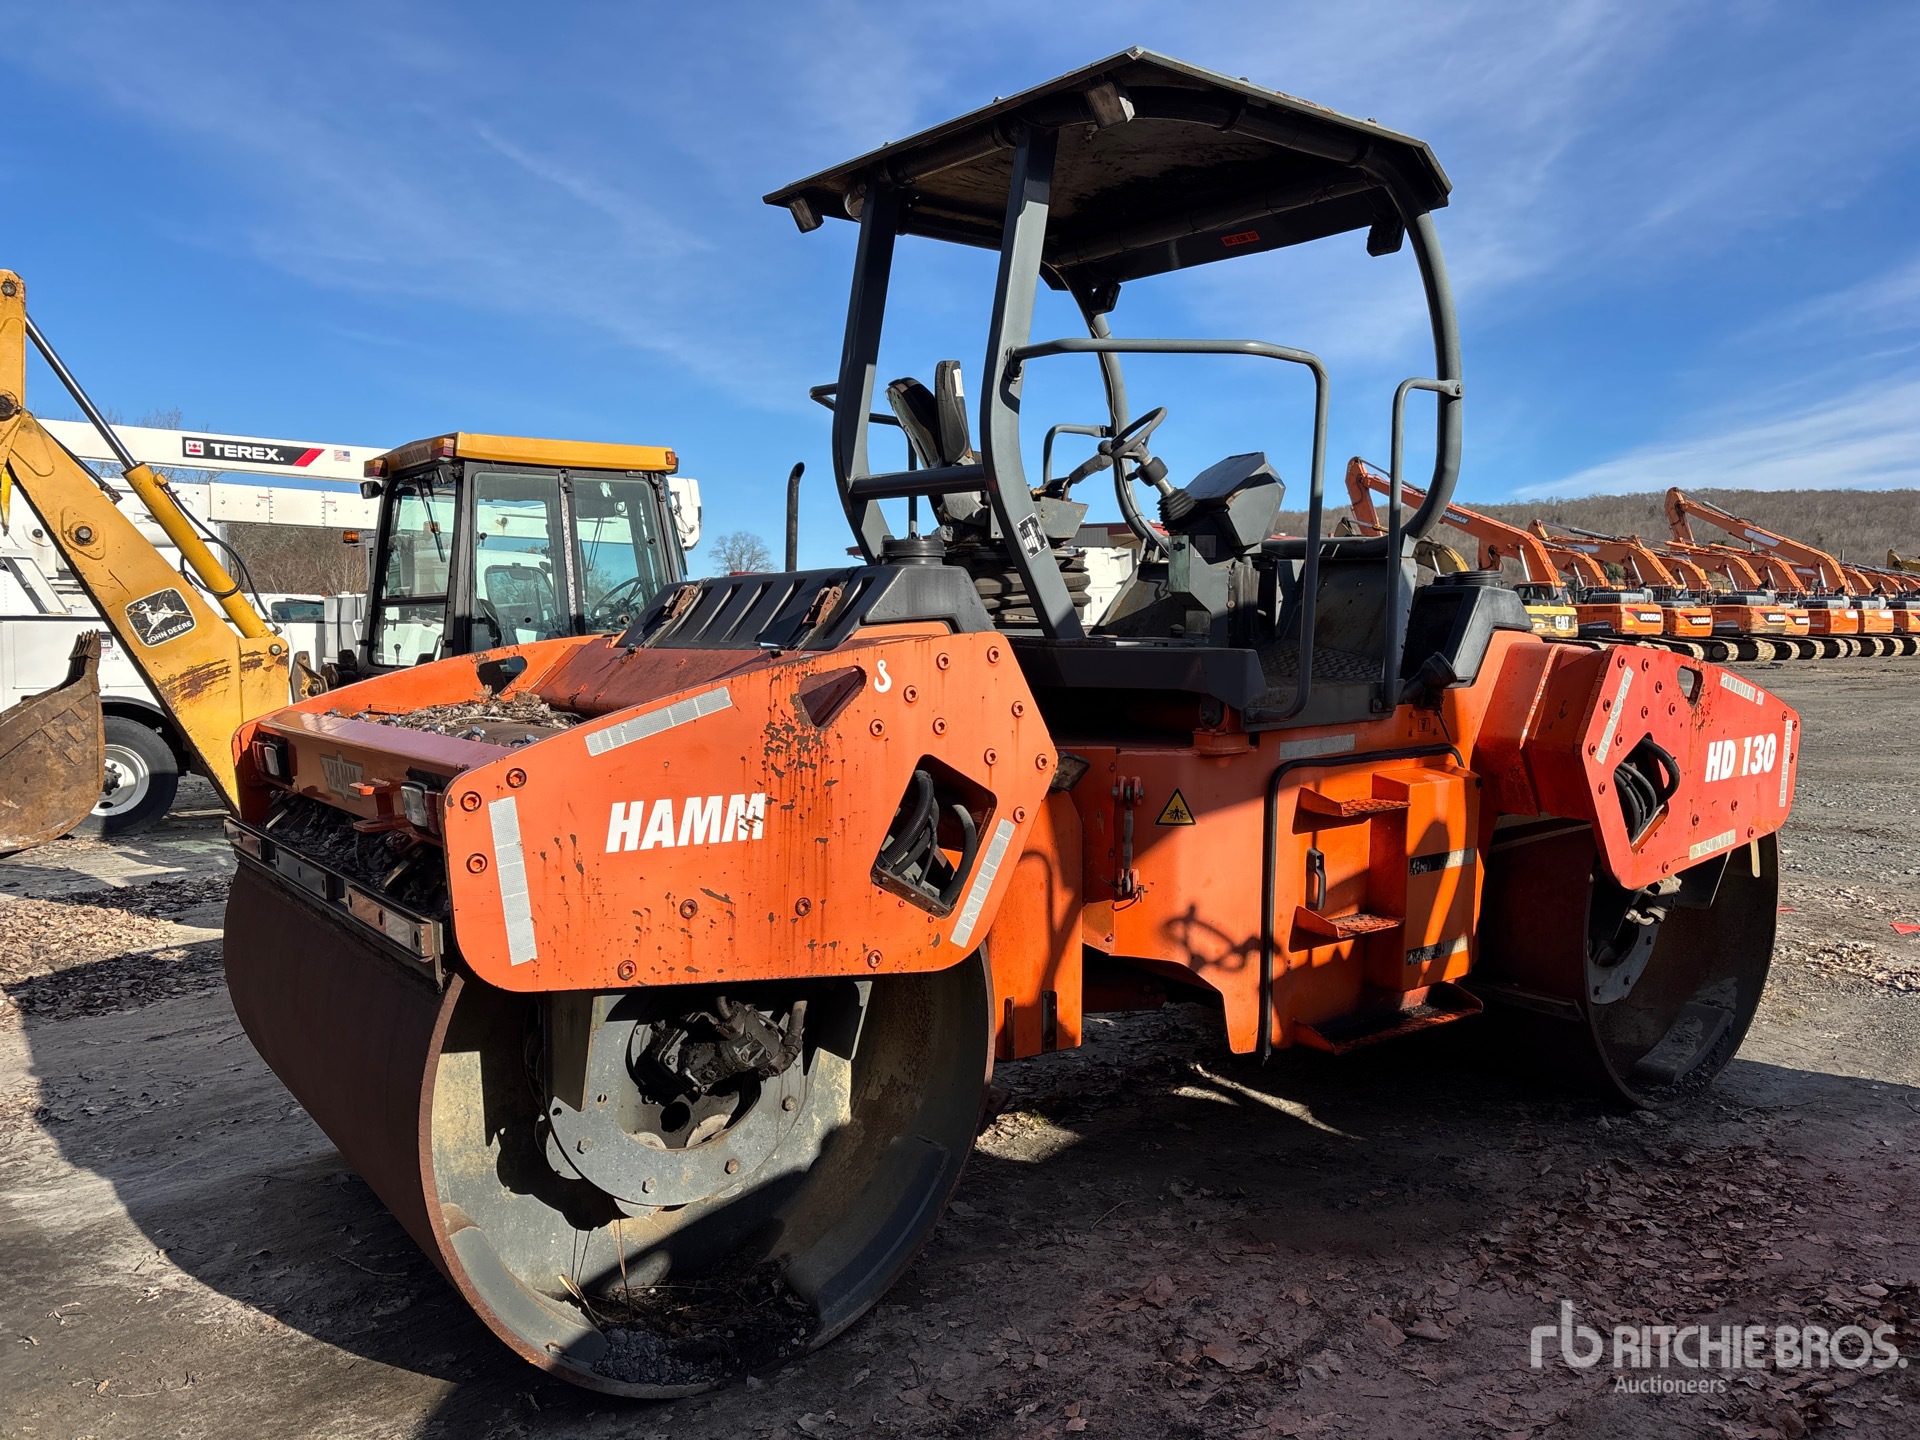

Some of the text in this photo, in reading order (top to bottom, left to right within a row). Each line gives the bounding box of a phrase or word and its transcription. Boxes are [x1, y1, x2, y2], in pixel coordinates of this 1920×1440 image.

[147, 620, 193, 644] JOHN DEERE
[1555, 615, 1570, 630] CAT
[1704, 732, 1777, 783] HD 130
[605, 793, 766, 853] HAMM
